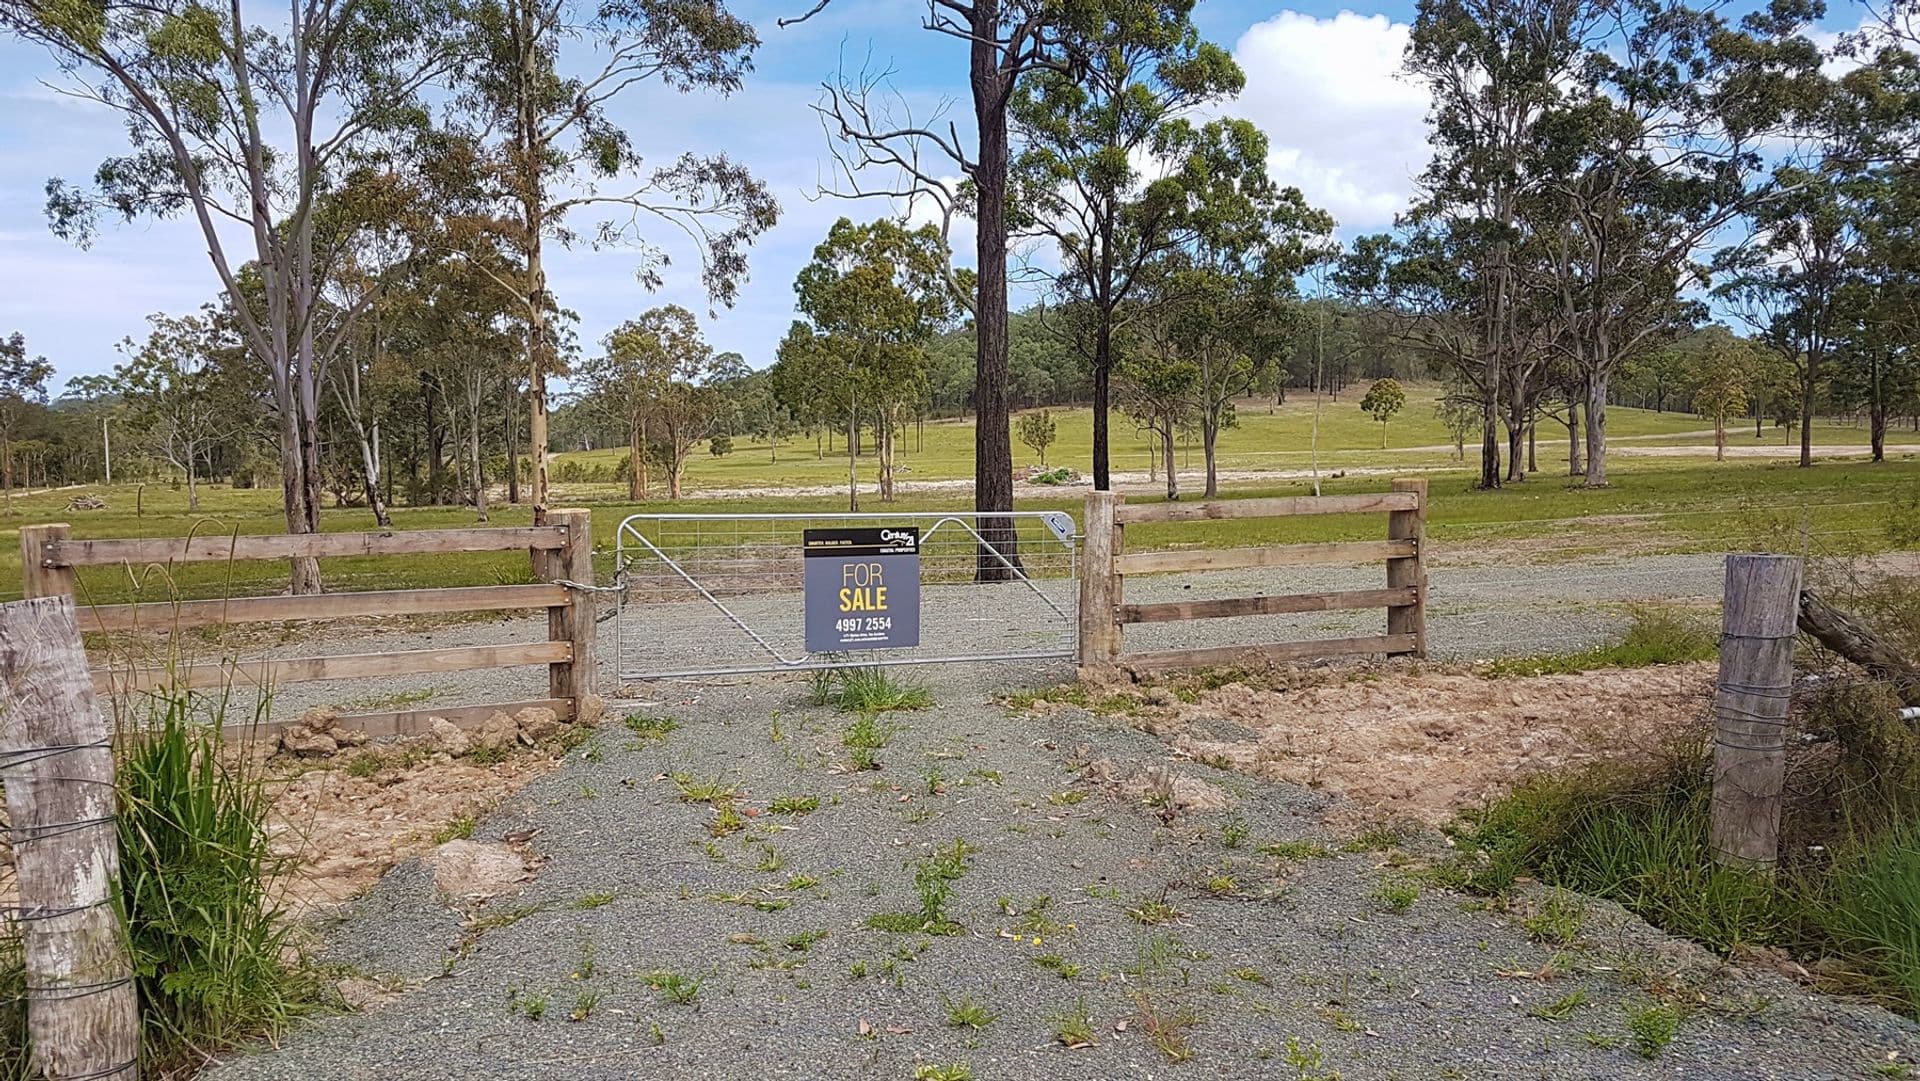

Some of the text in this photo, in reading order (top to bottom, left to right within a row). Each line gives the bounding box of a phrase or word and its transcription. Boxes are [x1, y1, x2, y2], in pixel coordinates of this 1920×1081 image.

[880, 529, 909, 541] Century
[904, 535, 915, 546] 21
[843, 563, 883, 587] FOR
[839, 586, 888, 612] SALE
[835, 617, 892, 632] 4997 2554
